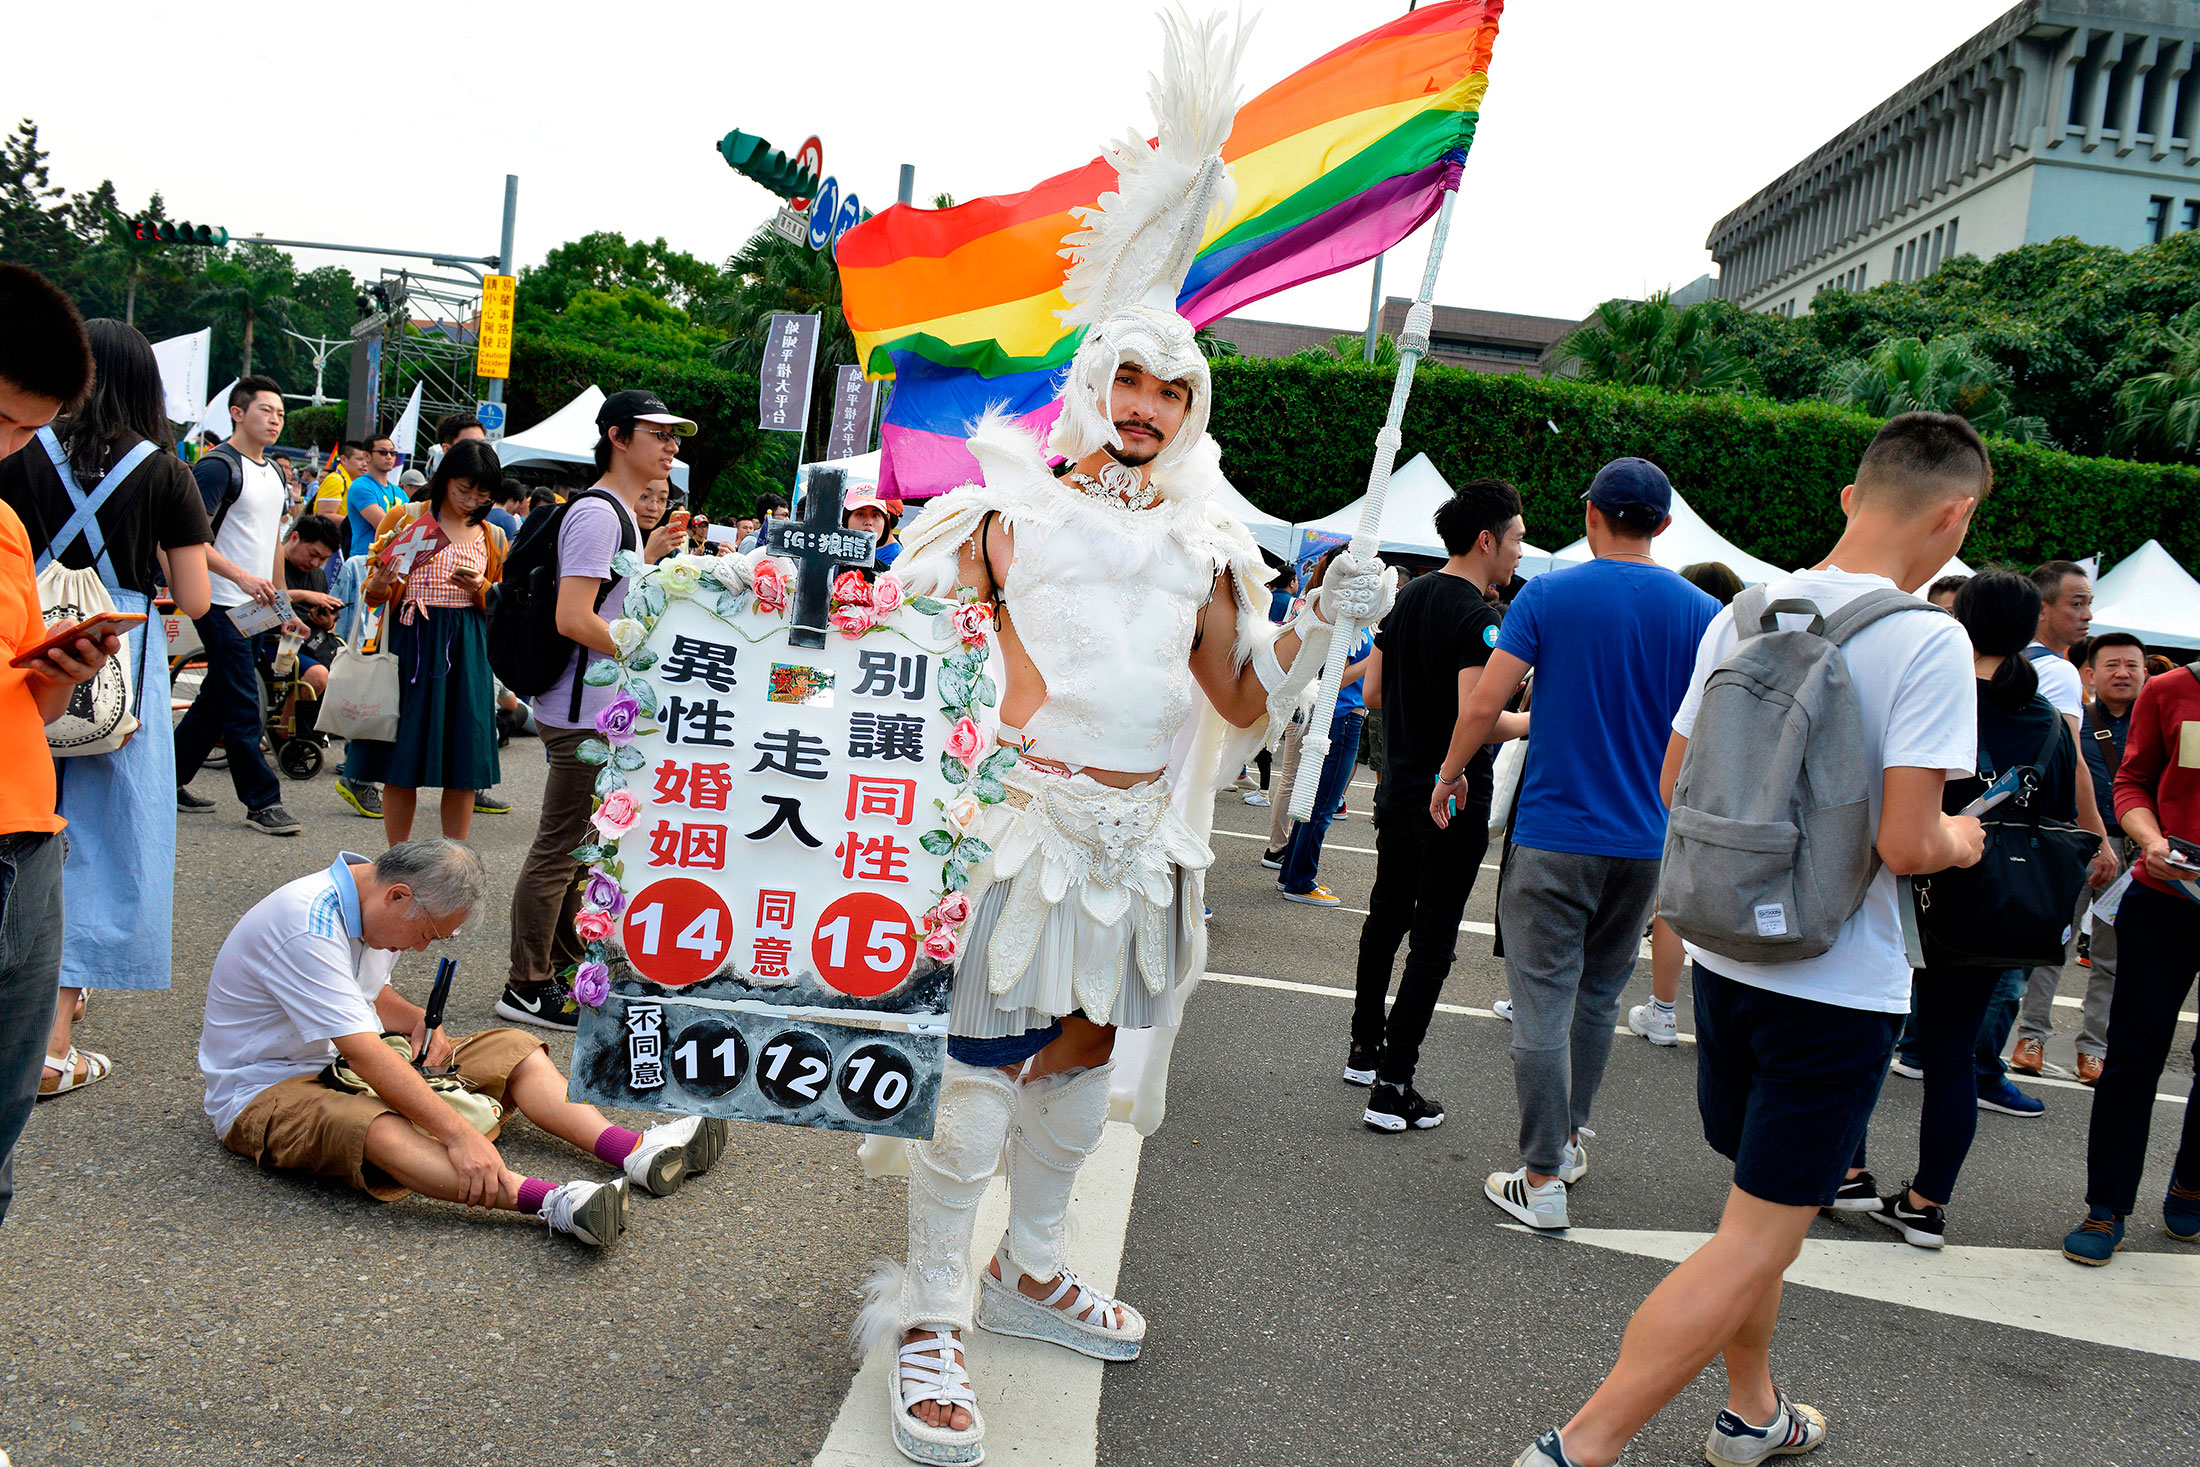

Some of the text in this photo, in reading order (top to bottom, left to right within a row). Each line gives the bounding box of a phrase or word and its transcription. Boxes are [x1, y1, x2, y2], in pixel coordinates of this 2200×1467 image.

[482, 278, 498, 348] 請小心駕駛
[497, 278, 513, 349] 易肇事路段
[479, 359, 508, 367] Accident
[646, 634, 739, 871] 異性婚姻
[834, 649, 929, 883] 別讓同性
[744, 728, 832, 848] 走入
[629, 902, 722, 961] 14
[750, 888, 797, 978] 同意
[818, 915, 907, 973] 15
[628, 1006, 664, 1087] 不同意
[674, 1038, 739, 1080] 11
[765, 1044, 828, 1099] 12
[847, 1056, 908, 1109] 10
